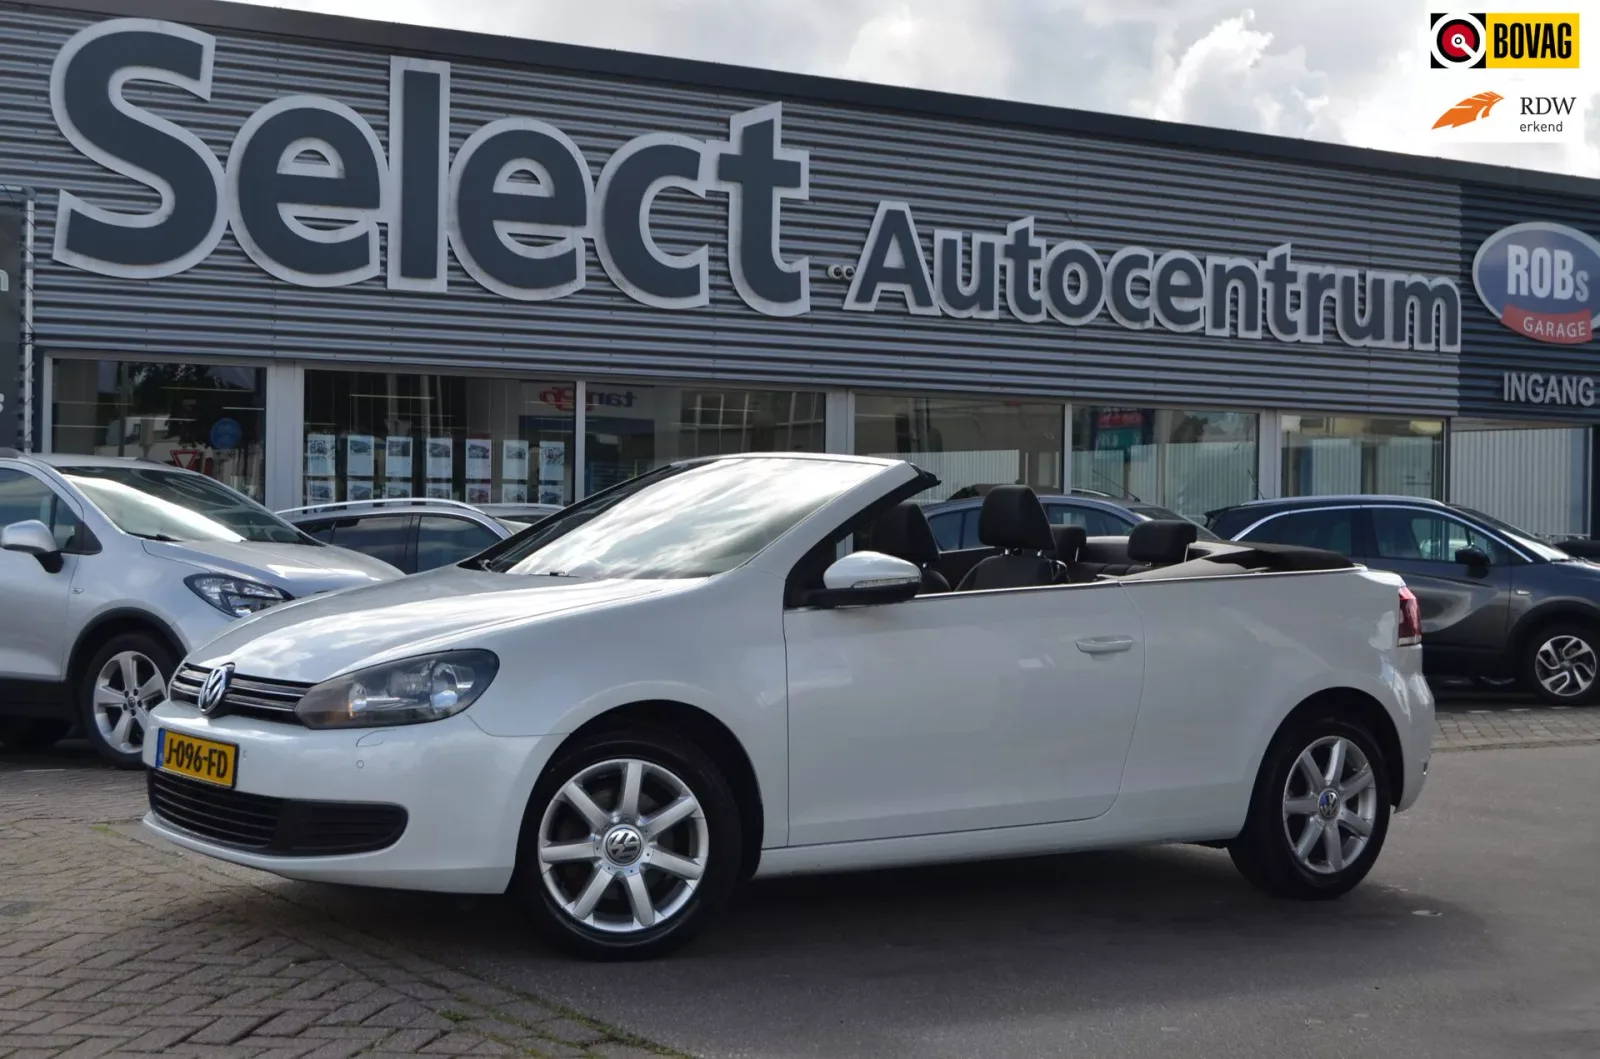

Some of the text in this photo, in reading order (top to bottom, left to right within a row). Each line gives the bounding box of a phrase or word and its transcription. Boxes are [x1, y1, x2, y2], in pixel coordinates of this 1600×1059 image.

[50, 18, 1462, 353] Select Autocentrum
[1507, 244, 1589, 302] ROBs
[1523, 316, 1587, 338] GARAGE
[1503, 372, 1595, 406] INGANG
[165, 738, 228, 779] J-096-FD
